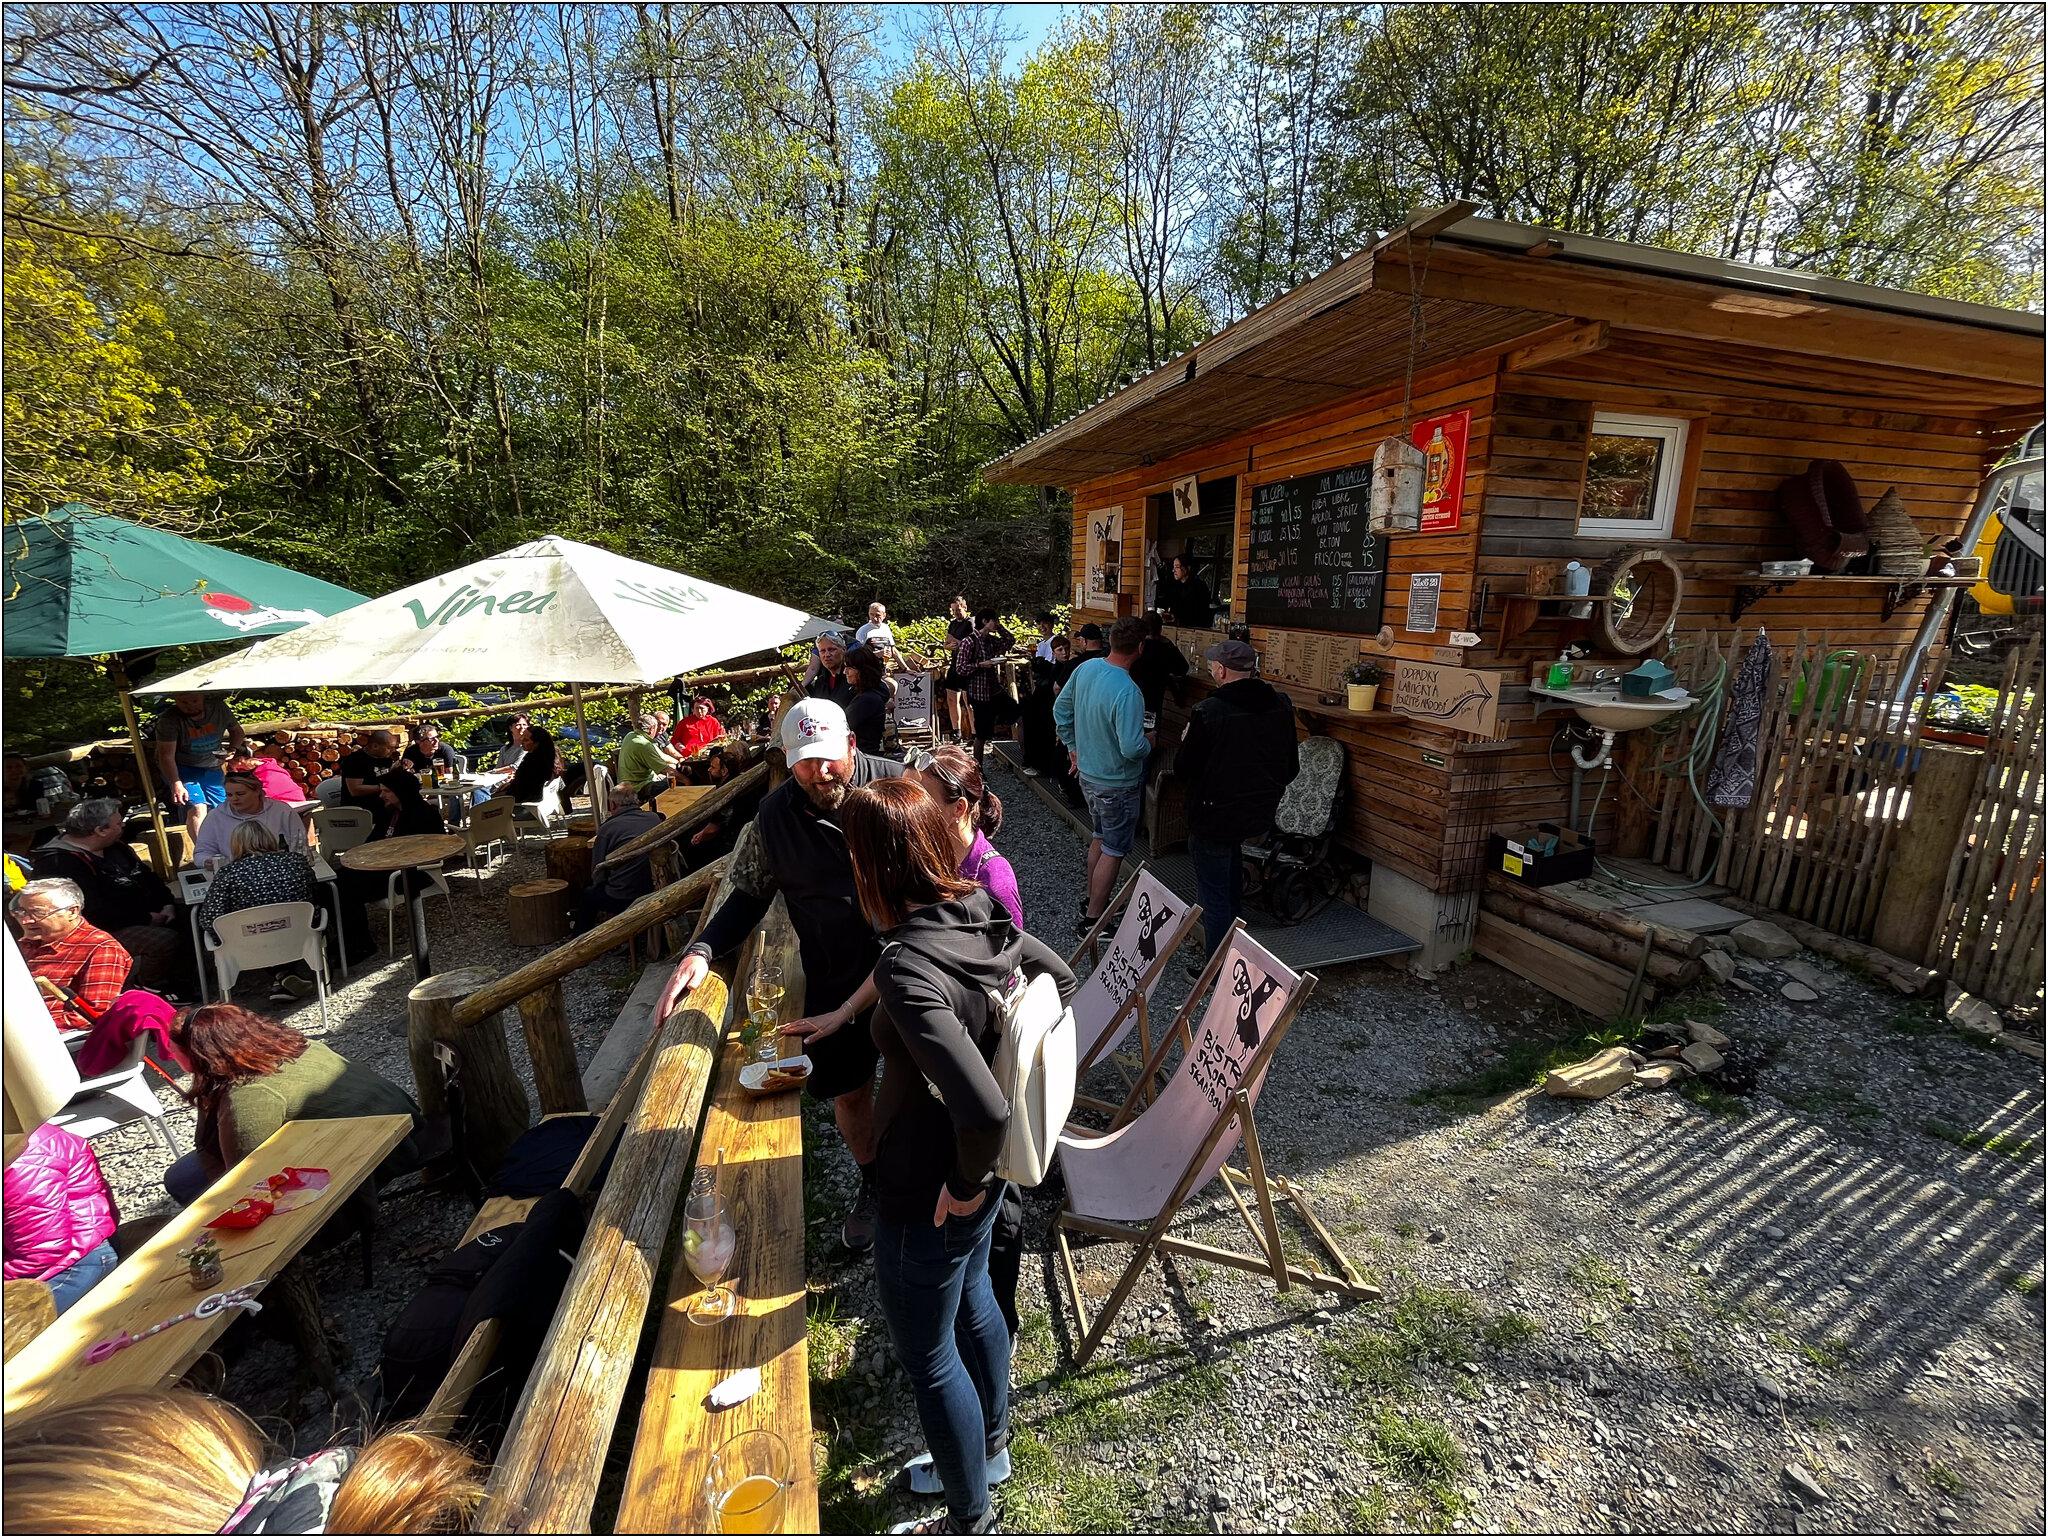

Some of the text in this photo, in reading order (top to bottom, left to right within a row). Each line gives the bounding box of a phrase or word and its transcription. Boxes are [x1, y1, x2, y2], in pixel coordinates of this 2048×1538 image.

[1314, 551, 1342, 567] FRISCO
[403, 585, 557, 630] Vinea
[1402, 667, 1440, 683] ODPADKY
